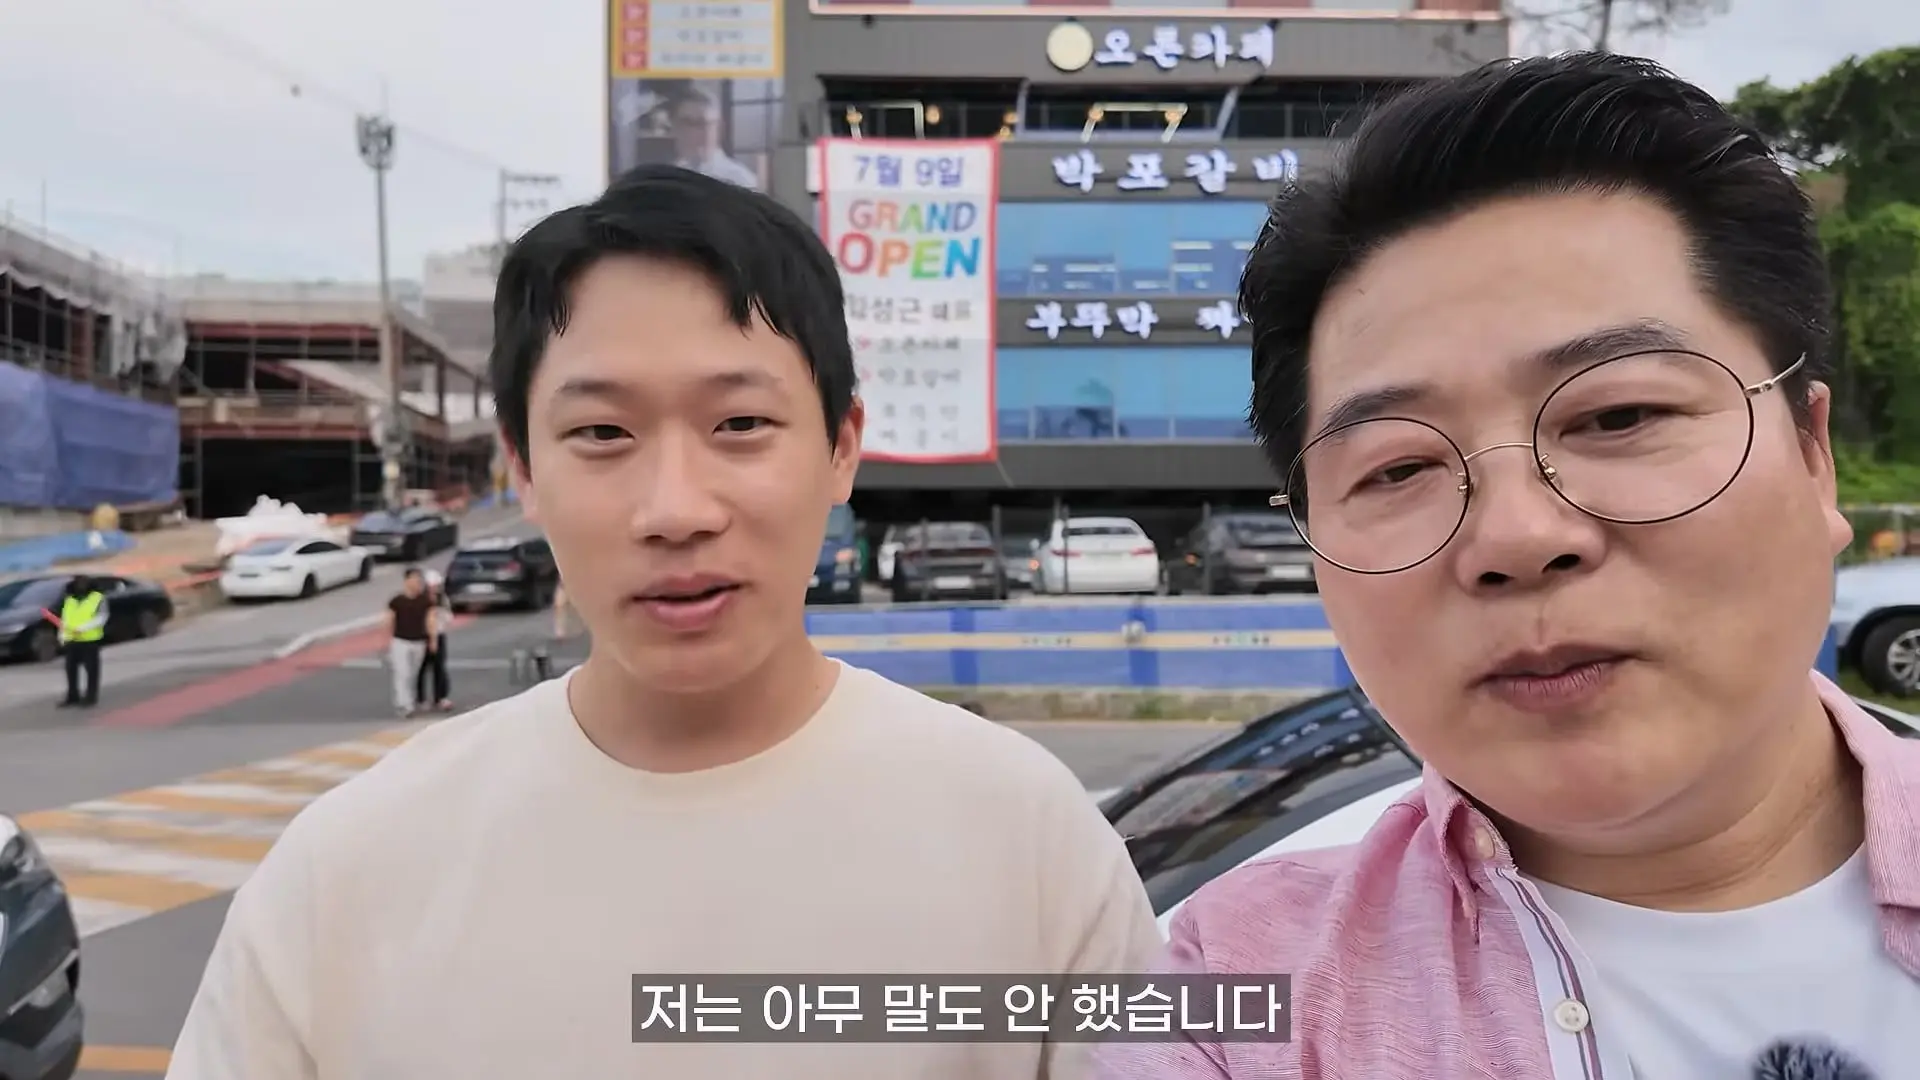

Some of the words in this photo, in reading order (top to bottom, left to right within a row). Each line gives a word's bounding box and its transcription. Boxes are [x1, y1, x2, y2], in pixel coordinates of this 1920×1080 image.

[854, 155, 902, 187] 7월
[915, 156, 963, 187] 9일
[1051, 148, 1299, 194] 박포갈비
[848, 200, 977, 233] GRAND
[838, 232, 981, 279] OPEN
